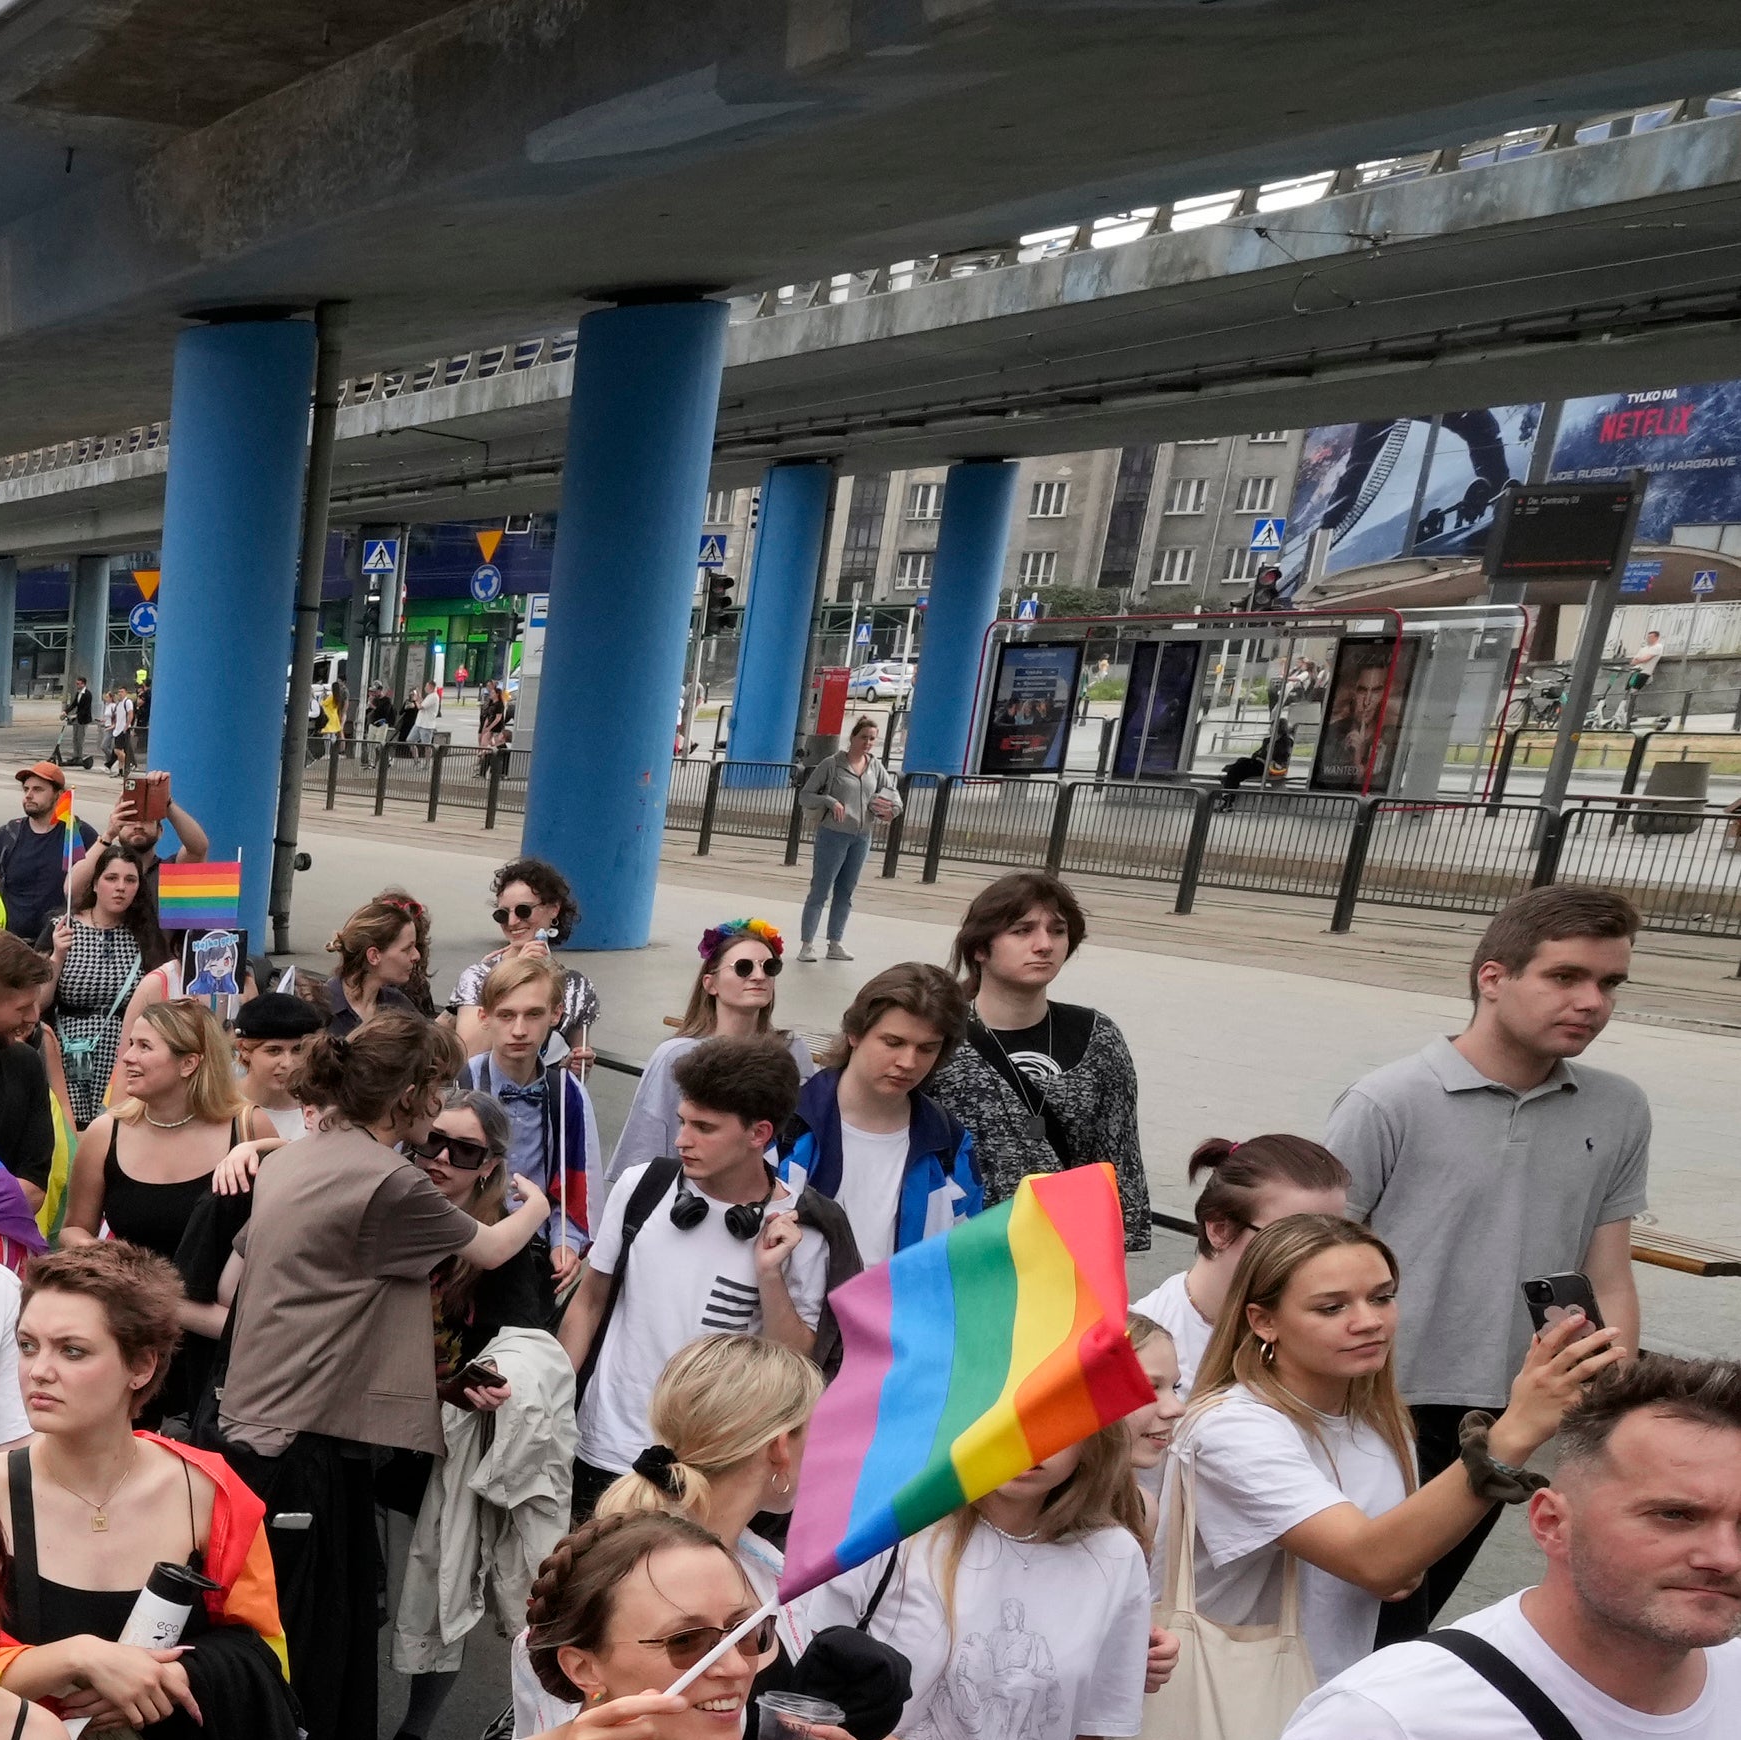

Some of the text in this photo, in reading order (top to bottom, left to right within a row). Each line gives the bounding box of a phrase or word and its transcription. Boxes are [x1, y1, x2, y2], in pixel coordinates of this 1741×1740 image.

[1627, 388, 1678, 405] TYLKO NA
[1599, 404, 1695, 443] NETFLIX
[1667, 455, 1737, 472] HARGRAVE
[156, 1621, 179, 1633] eco
